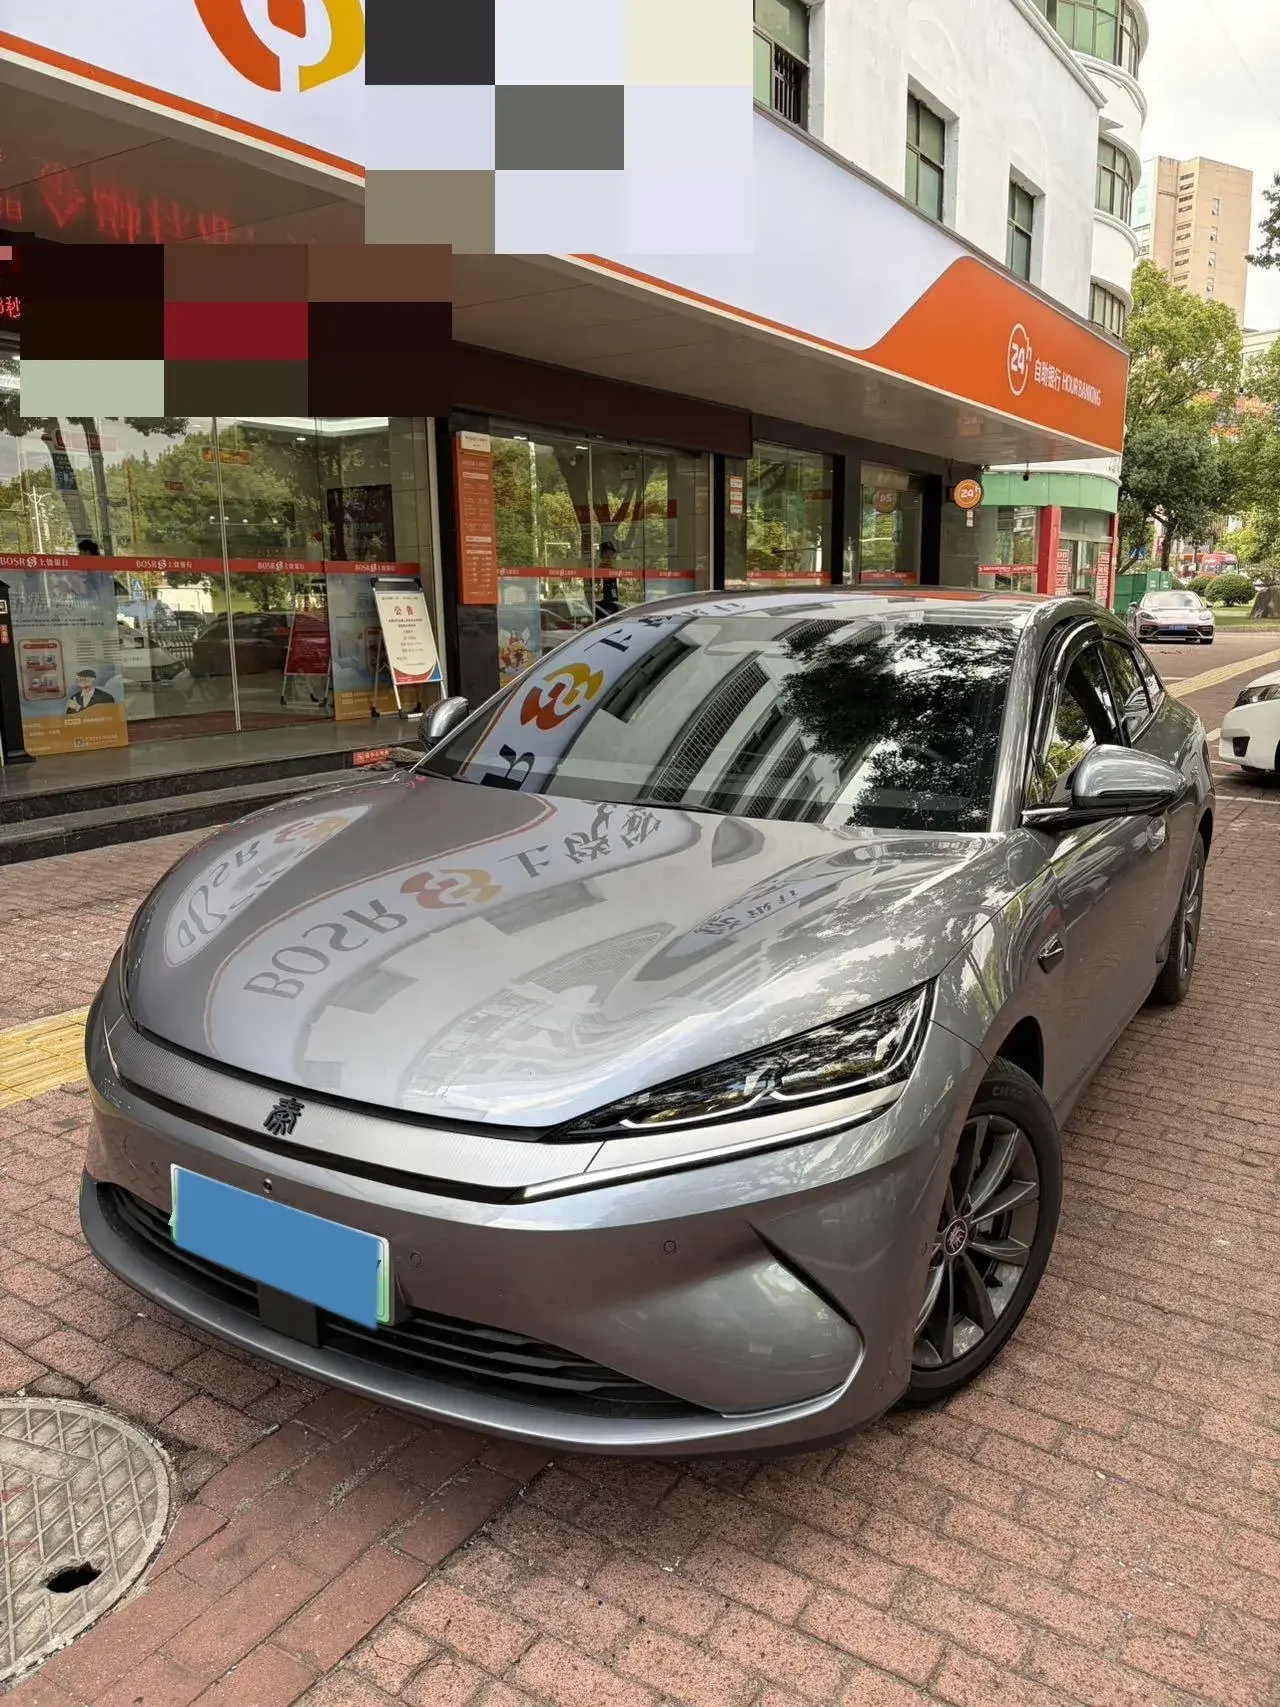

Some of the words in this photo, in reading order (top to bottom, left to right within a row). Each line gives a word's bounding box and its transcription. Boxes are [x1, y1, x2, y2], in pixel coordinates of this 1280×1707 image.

[1034, 358, 1061, 392] 自助银行
[0, 557, 26, 566] BOSR
[136, 560, 157, 568] BOSR
[393, 605, 415, 616] 公告
